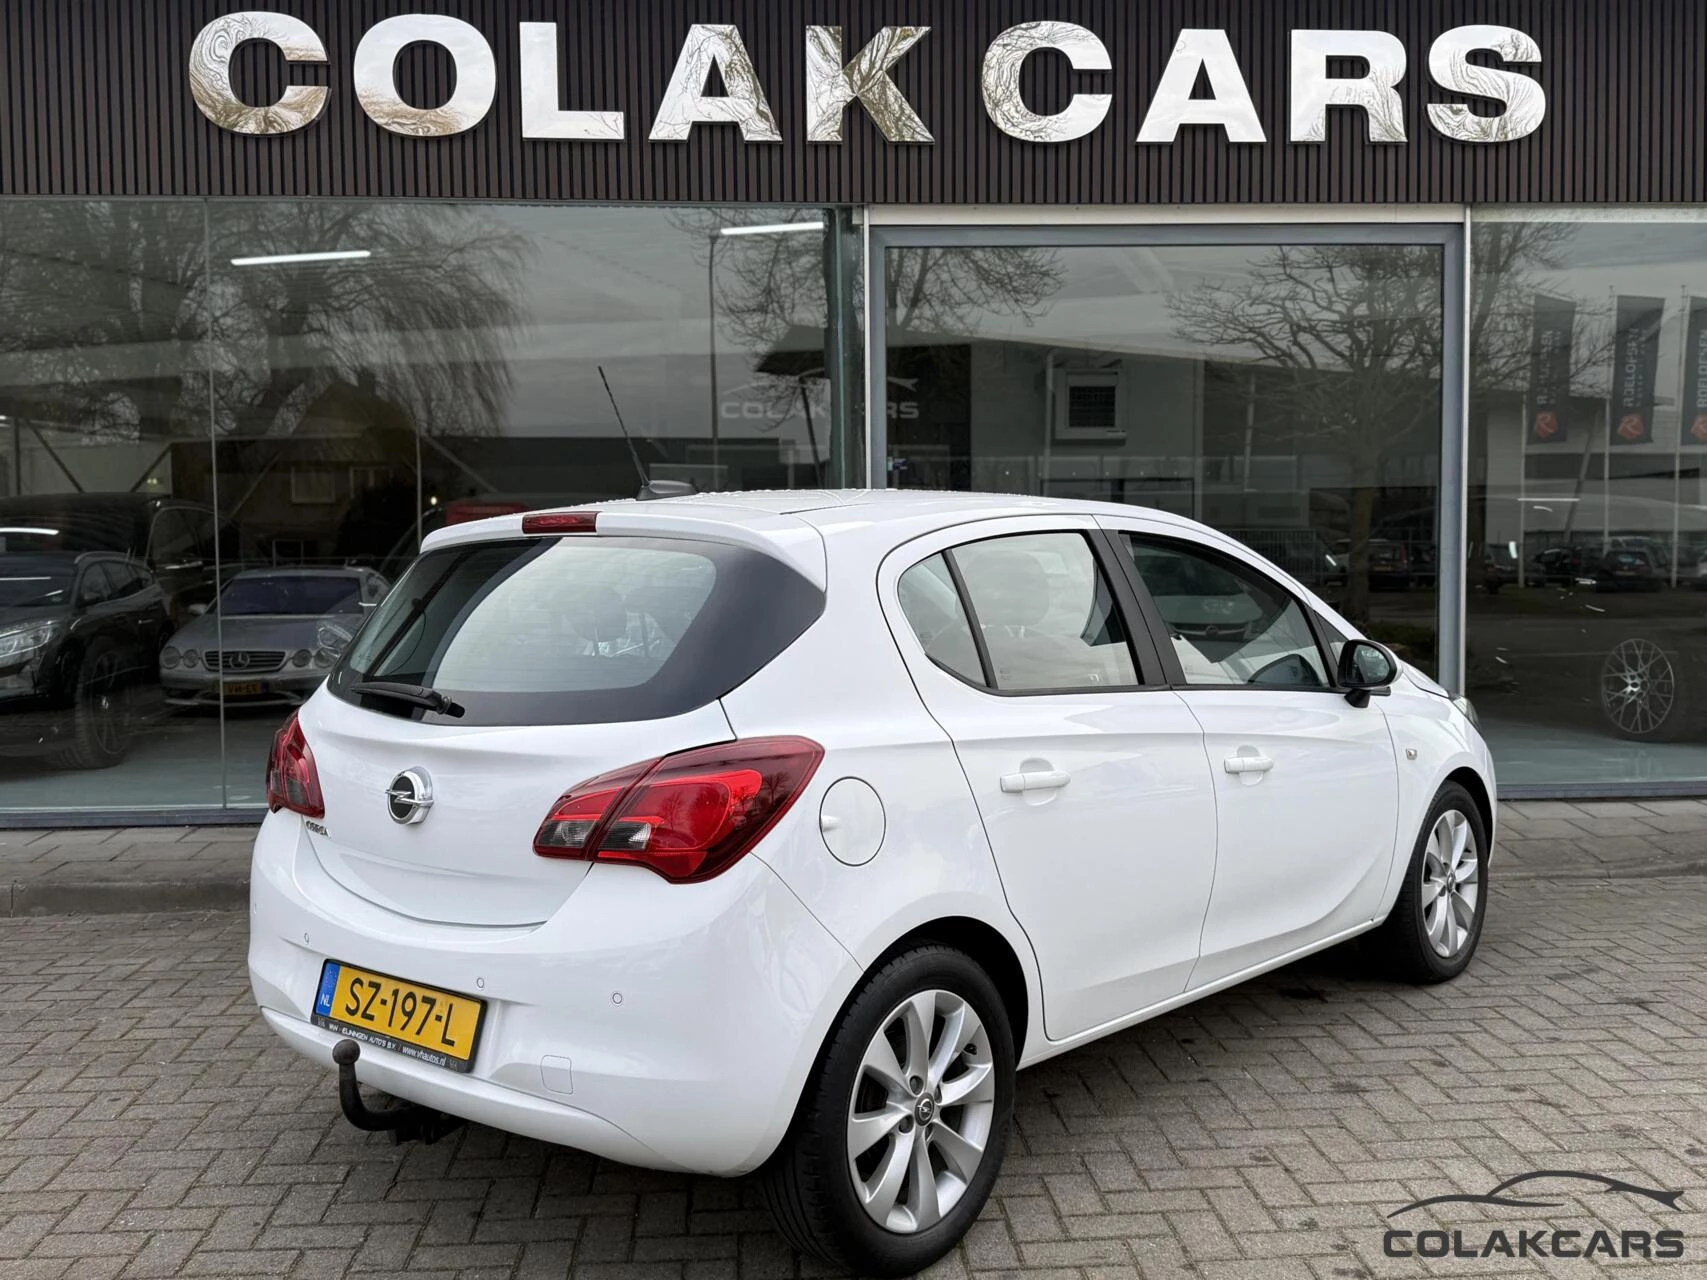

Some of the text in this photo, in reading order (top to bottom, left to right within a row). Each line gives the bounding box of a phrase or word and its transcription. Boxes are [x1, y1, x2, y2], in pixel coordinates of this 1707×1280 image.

[189, 11, 1547, 144] COLAK CARS
[320, 993, 331, 1007] NL
[345, 977, 456, 1047] SZ-197-L
